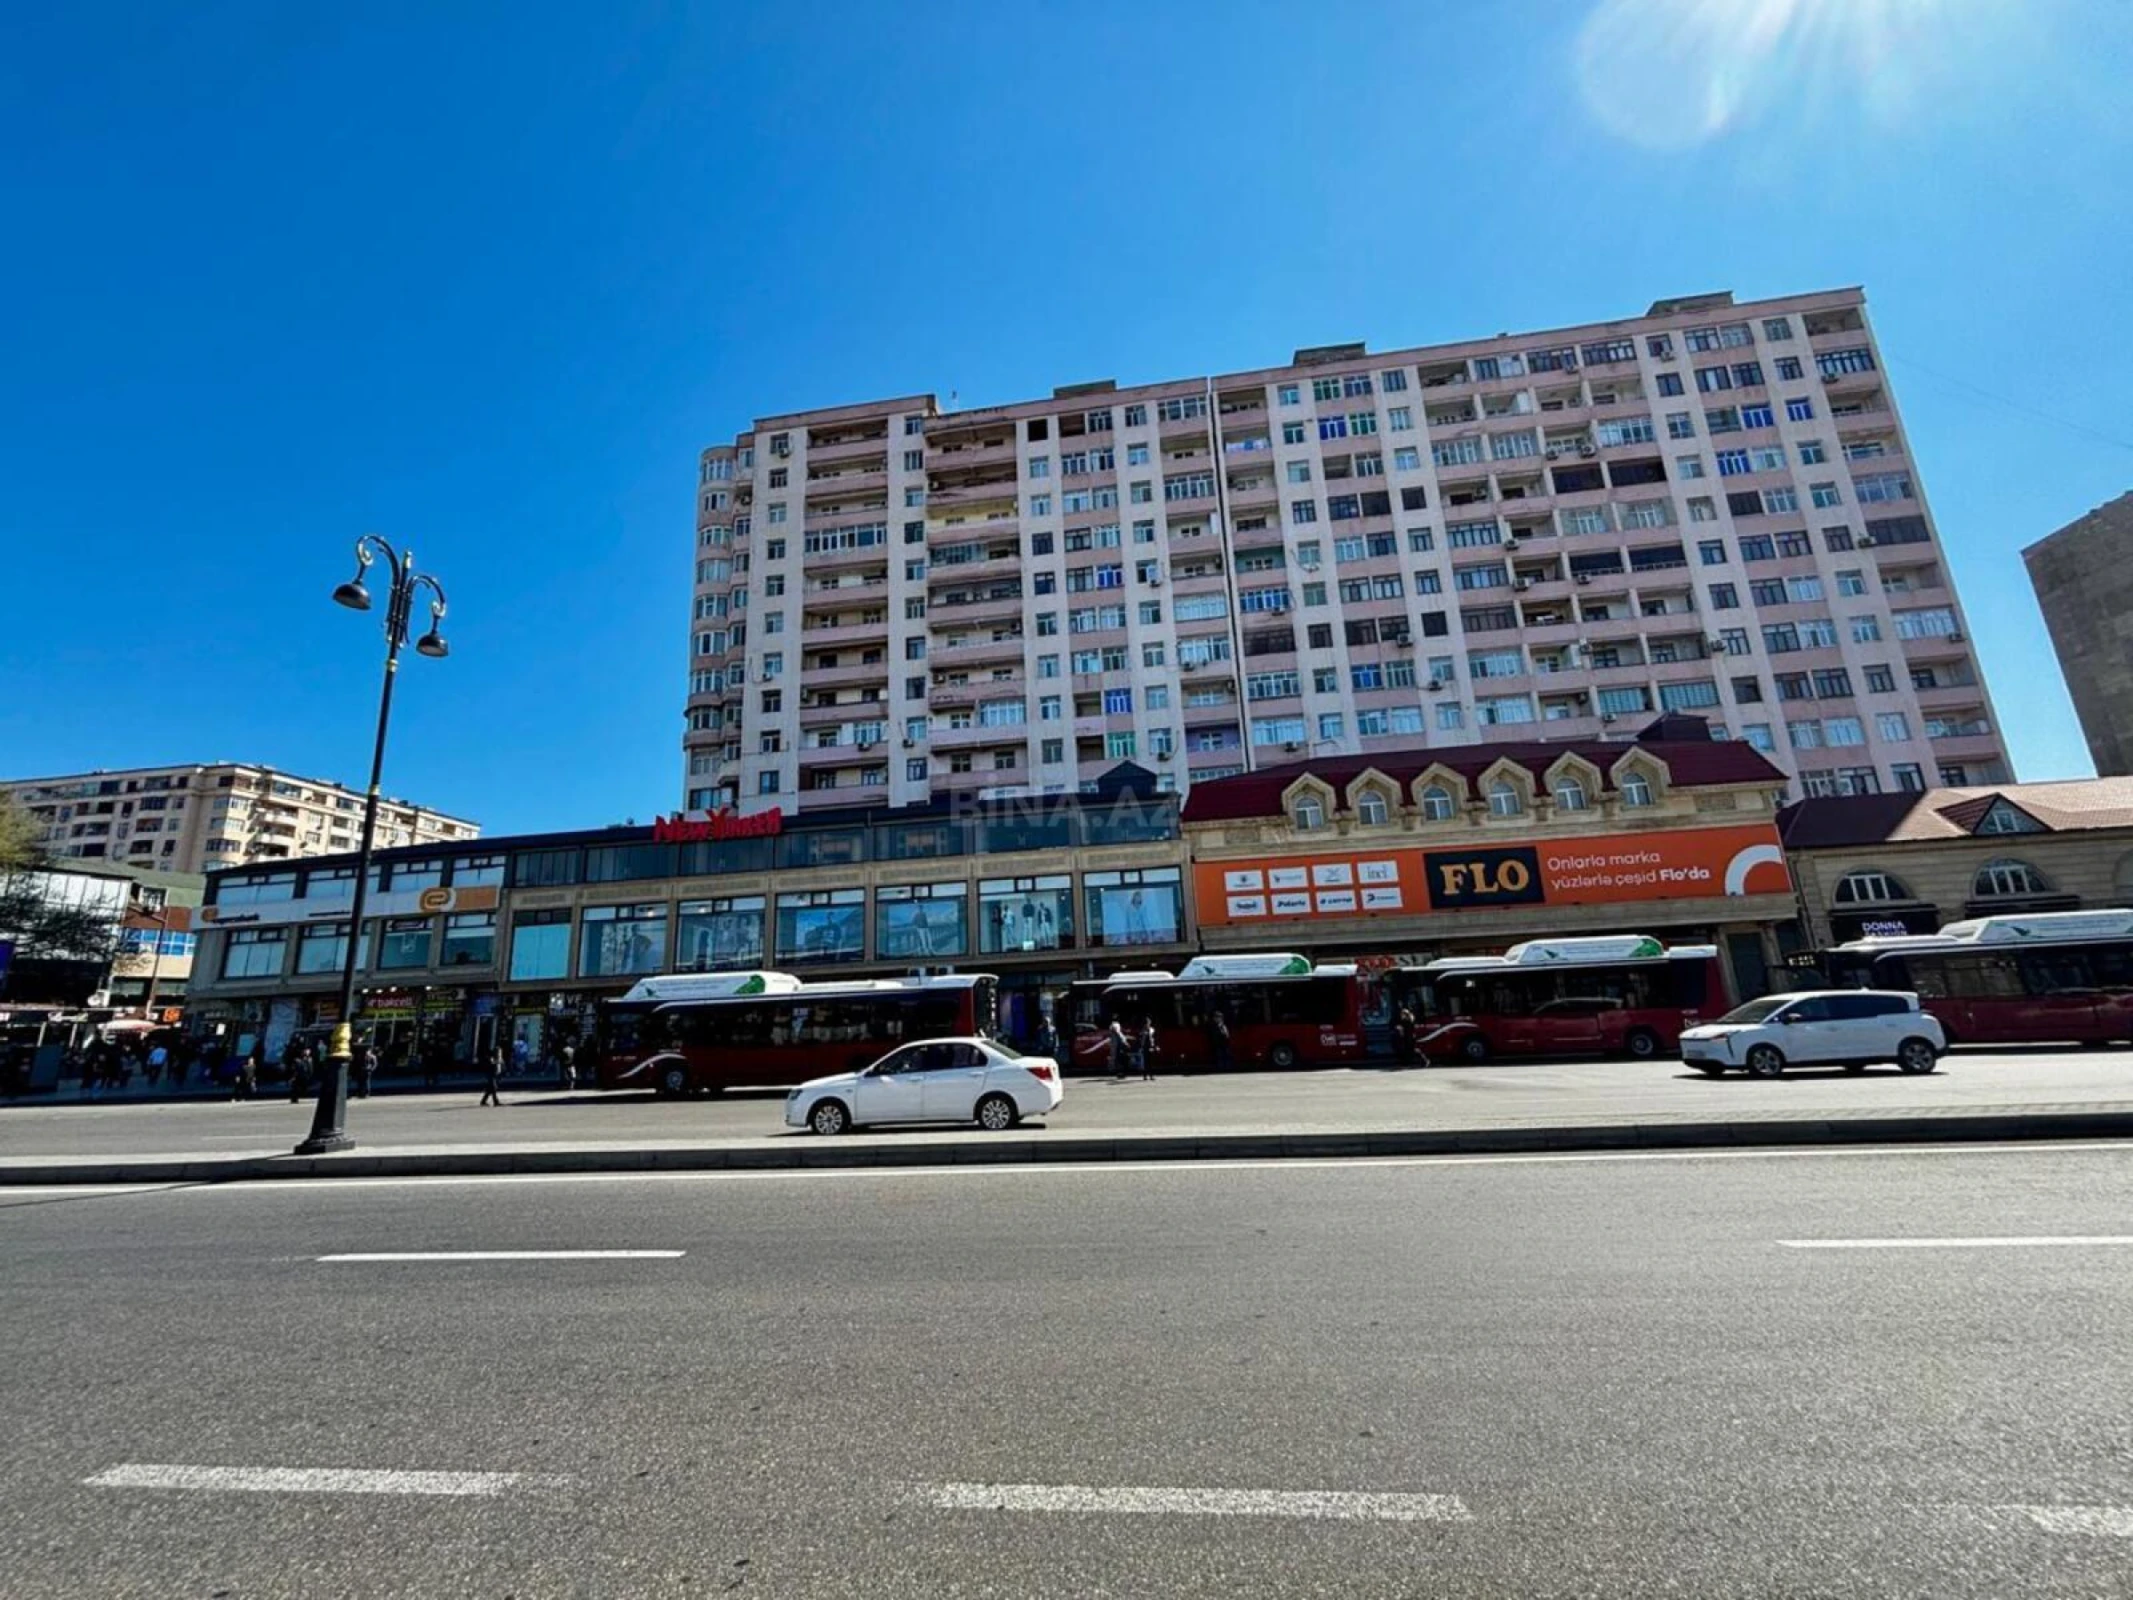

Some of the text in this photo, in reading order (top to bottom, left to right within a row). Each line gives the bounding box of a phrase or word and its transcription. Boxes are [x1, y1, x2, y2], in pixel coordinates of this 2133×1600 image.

[1547, 850, 1661, 871] Onlarla marka
[1439, 860, 1530, 895] FLO
[1659, 866, 1711, 882] Flo'da
[1861, 920, 1906, 931] DONNA
